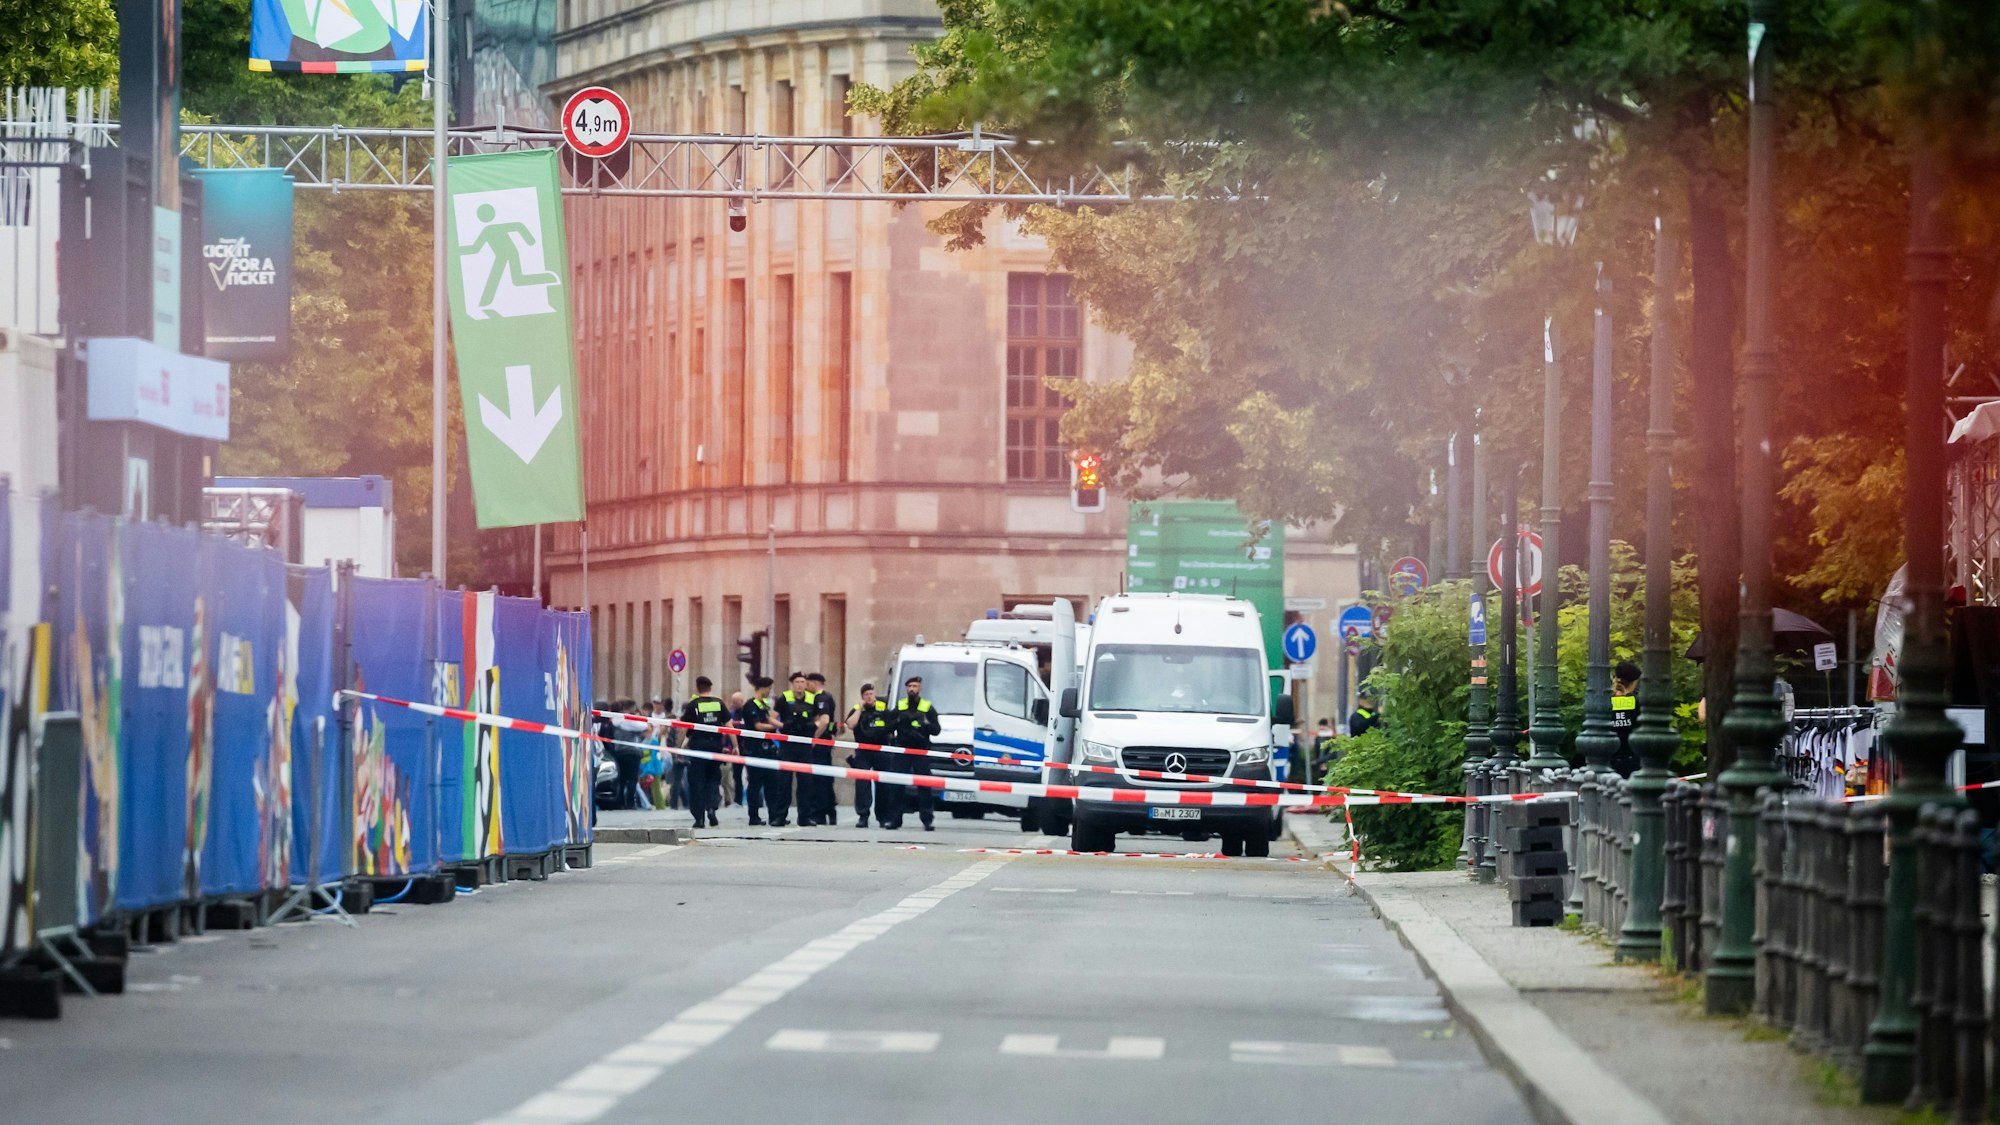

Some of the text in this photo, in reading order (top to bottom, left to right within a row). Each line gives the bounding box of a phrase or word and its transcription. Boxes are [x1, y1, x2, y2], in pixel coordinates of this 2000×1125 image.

[236, 244, 251, 257] IT
[231, 258, 274, 271] FOR A
[226, 271, 276, 285] TICKET
[1615, 712, 1626, 720] BE
[1153, 808, 1200, 818] B MI 2307
